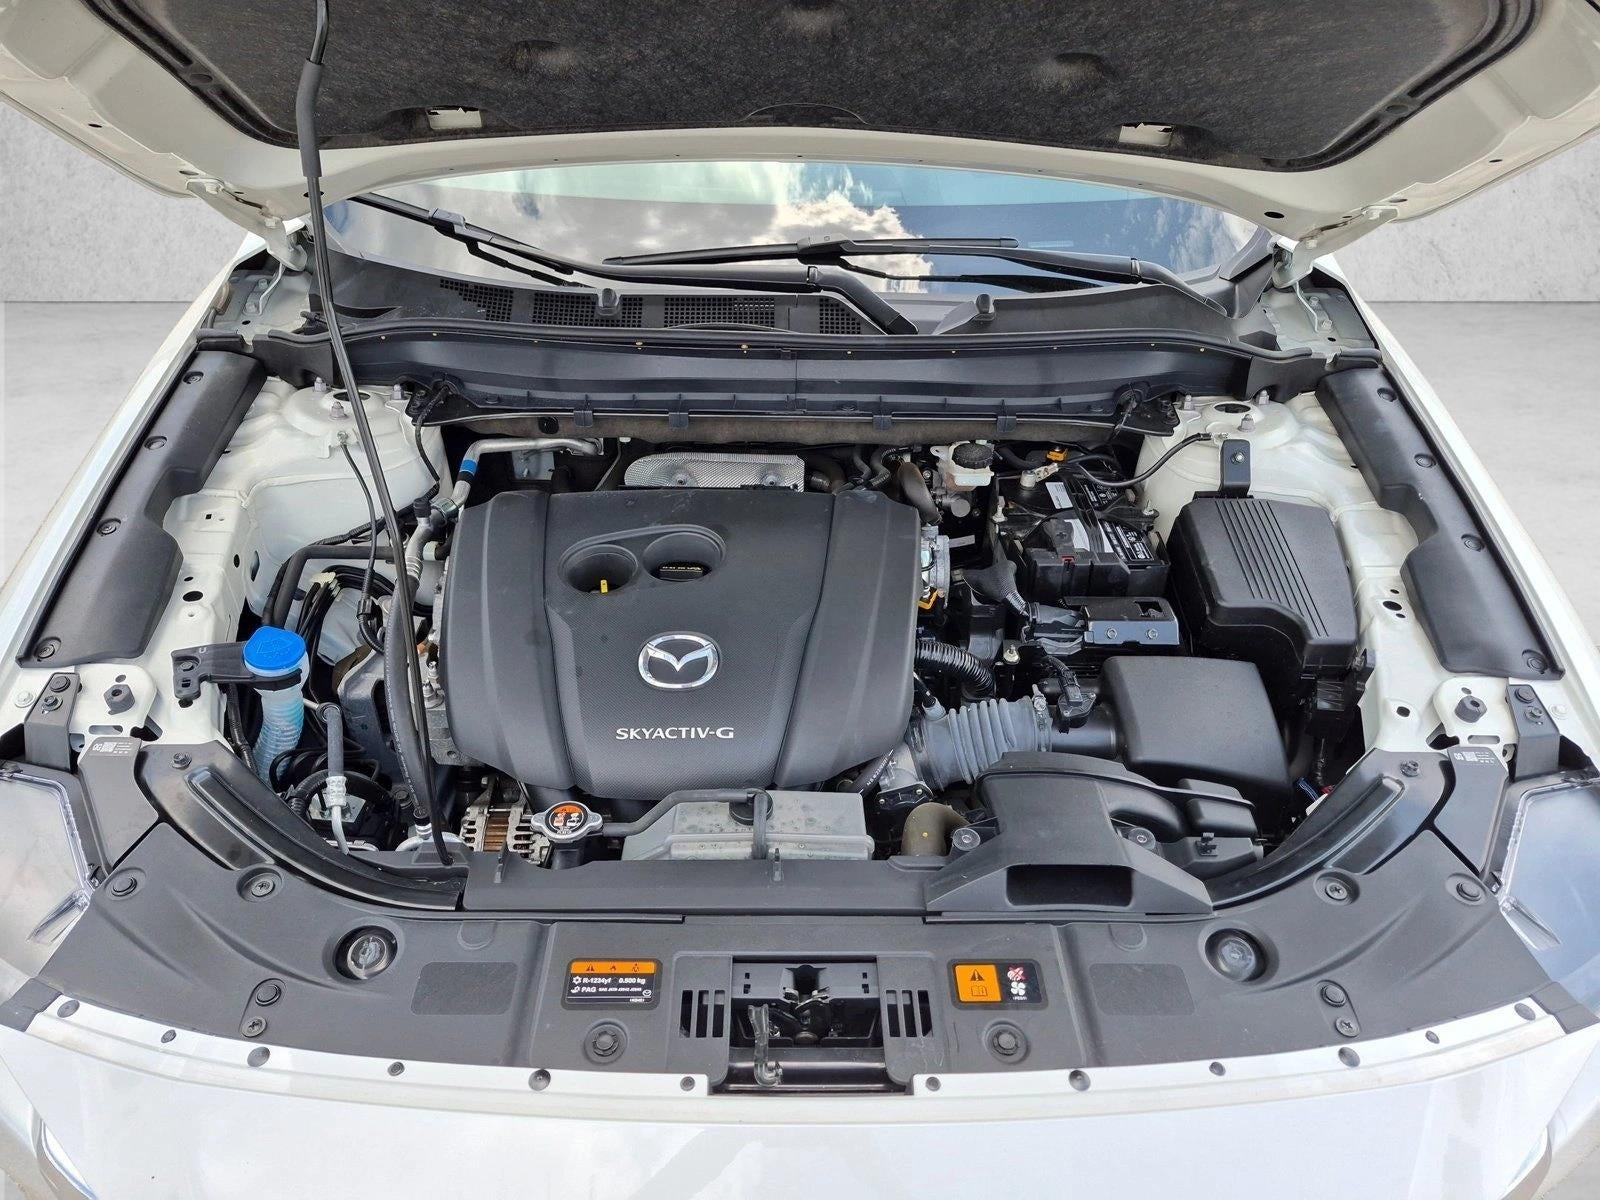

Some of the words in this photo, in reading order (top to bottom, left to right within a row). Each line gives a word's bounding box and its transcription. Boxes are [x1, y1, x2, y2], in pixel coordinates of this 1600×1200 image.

[615, 726, 735, 741] SKYACTIV-G
[582, 977, 612, 985] R-1234yf
[636, 977, 647, 985] kg
